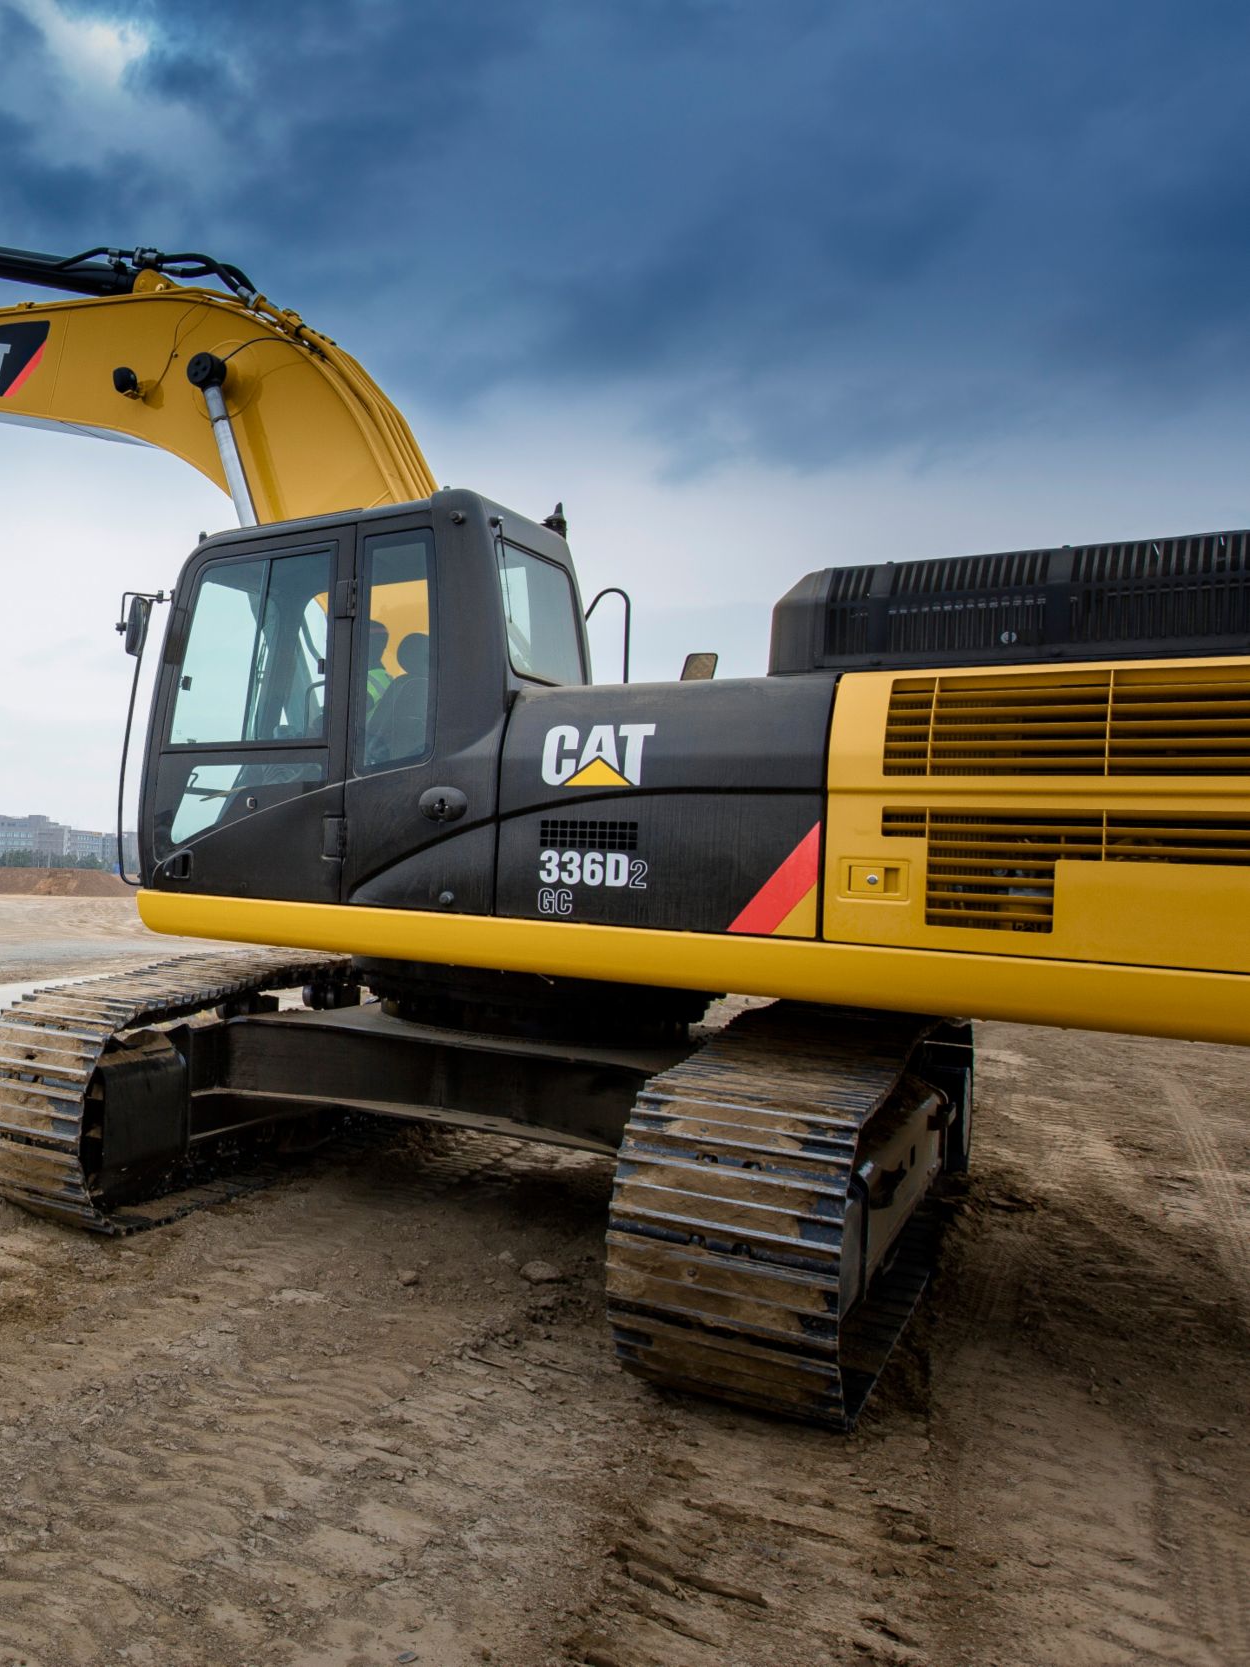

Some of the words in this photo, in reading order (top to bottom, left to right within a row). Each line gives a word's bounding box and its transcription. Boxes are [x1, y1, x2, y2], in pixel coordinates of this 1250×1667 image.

[541, 723, 656, 786] CAT
[539, 850, 648, 889] 336D2
[538, 887, 573, 915] GC
